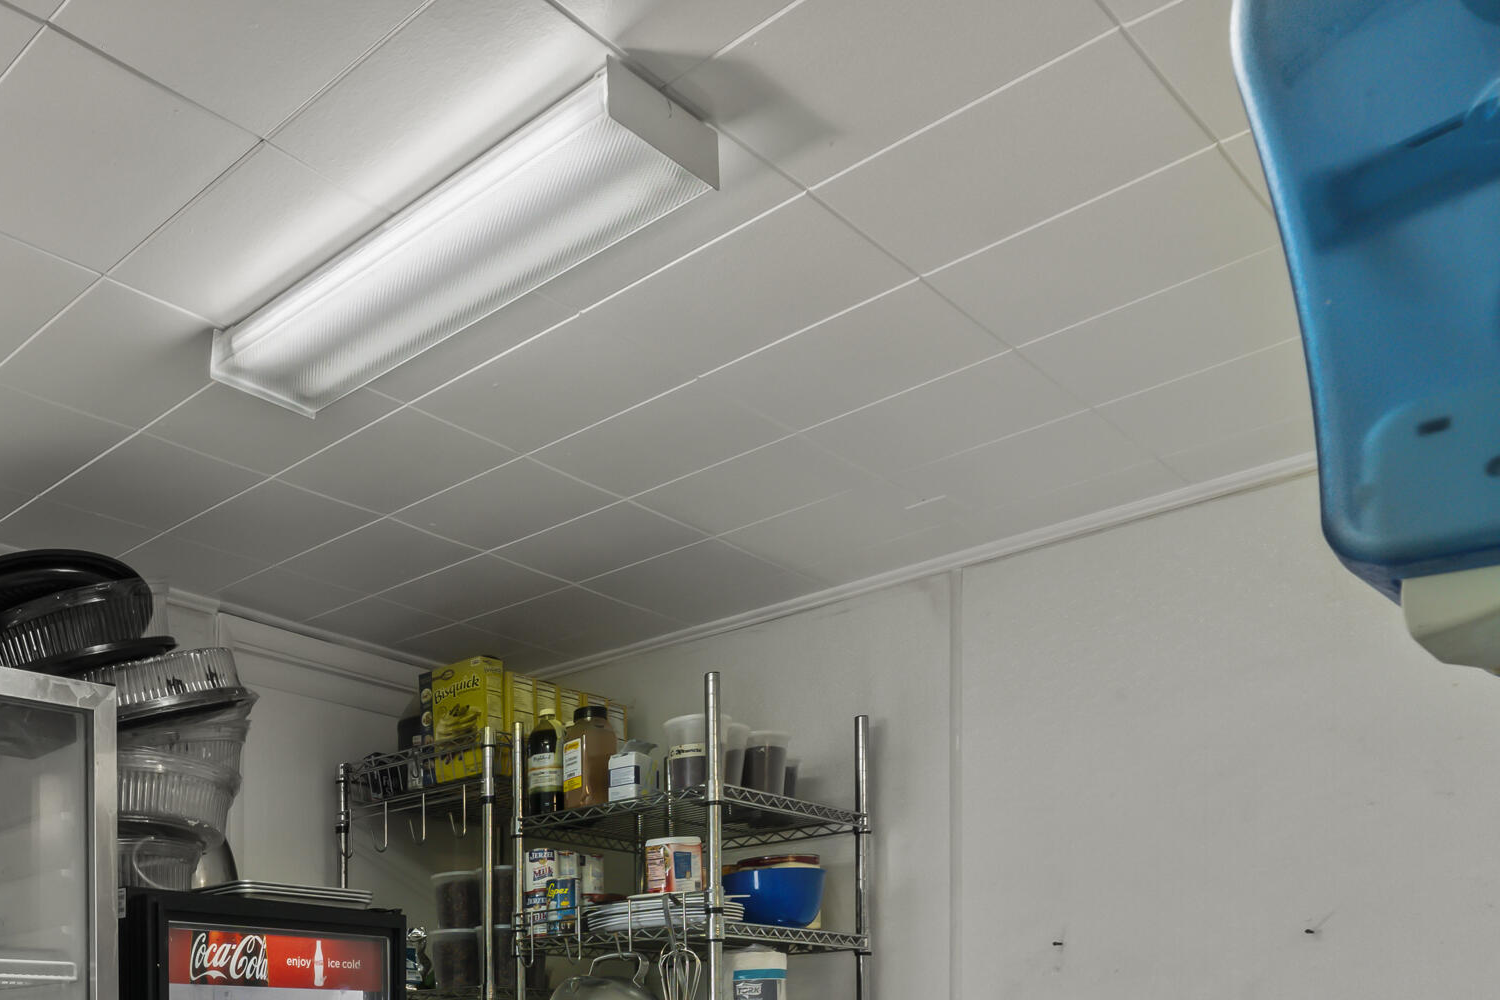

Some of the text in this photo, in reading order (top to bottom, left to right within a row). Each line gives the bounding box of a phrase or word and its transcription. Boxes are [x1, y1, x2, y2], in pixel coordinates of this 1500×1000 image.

[433, 674, 481, 705] Bisquick
[547, 883, 570, 899] Lopez
[189, 932, 269, 981] Coca-Cola
[286, 956, 361, 969] enjoy ice cold
